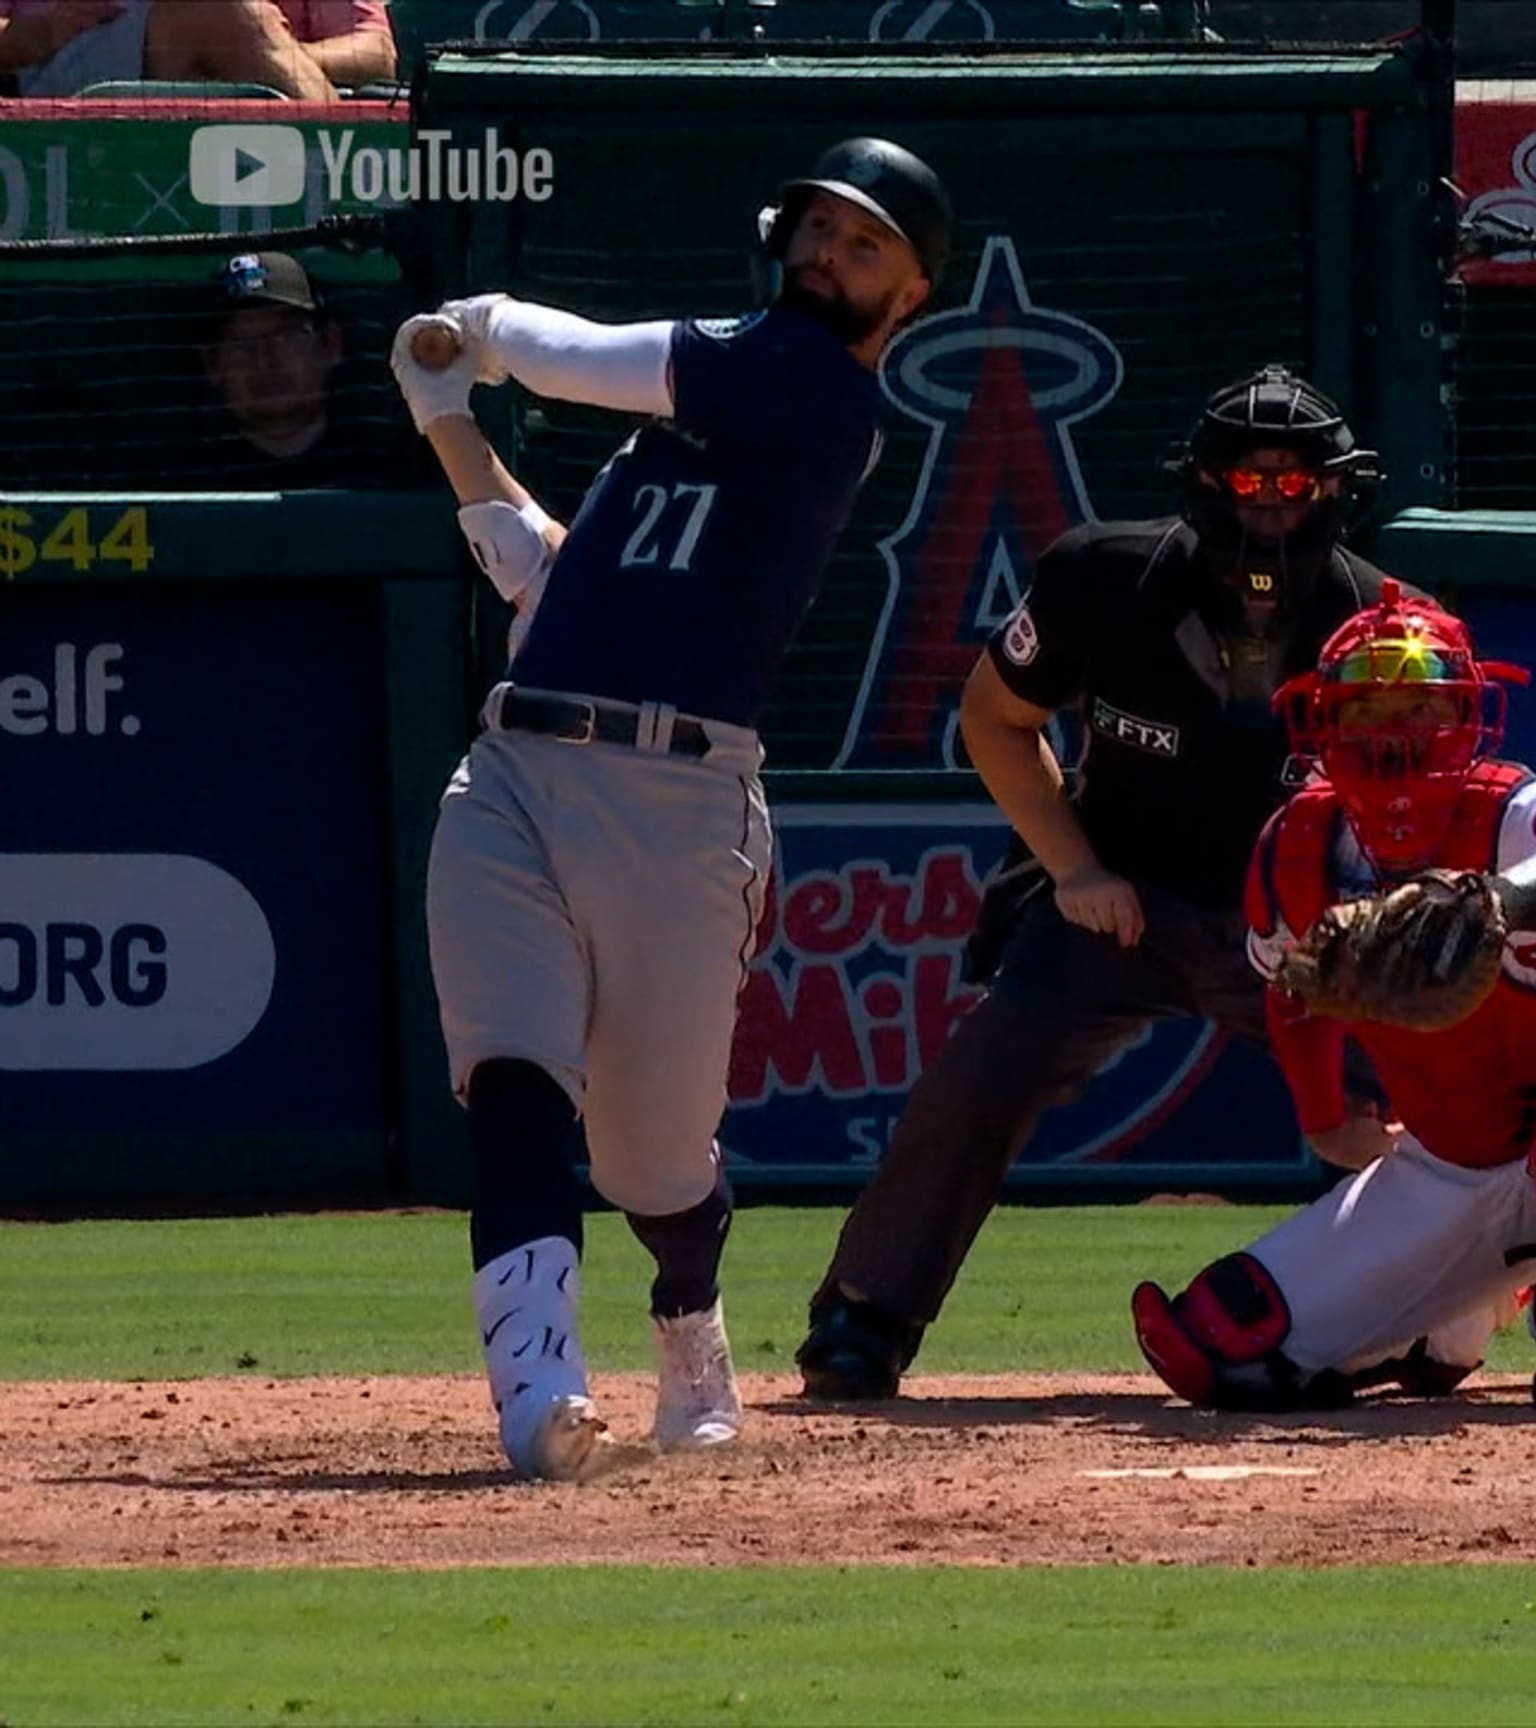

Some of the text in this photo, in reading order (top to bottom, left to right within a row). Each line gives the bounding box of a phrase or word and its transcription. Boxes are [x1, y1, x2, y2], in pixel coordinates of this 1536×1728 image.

[0, 506, 155, 580] $44
[619, 481, 719, 572] 27
[1116, 715, 1175, 752] FTX
